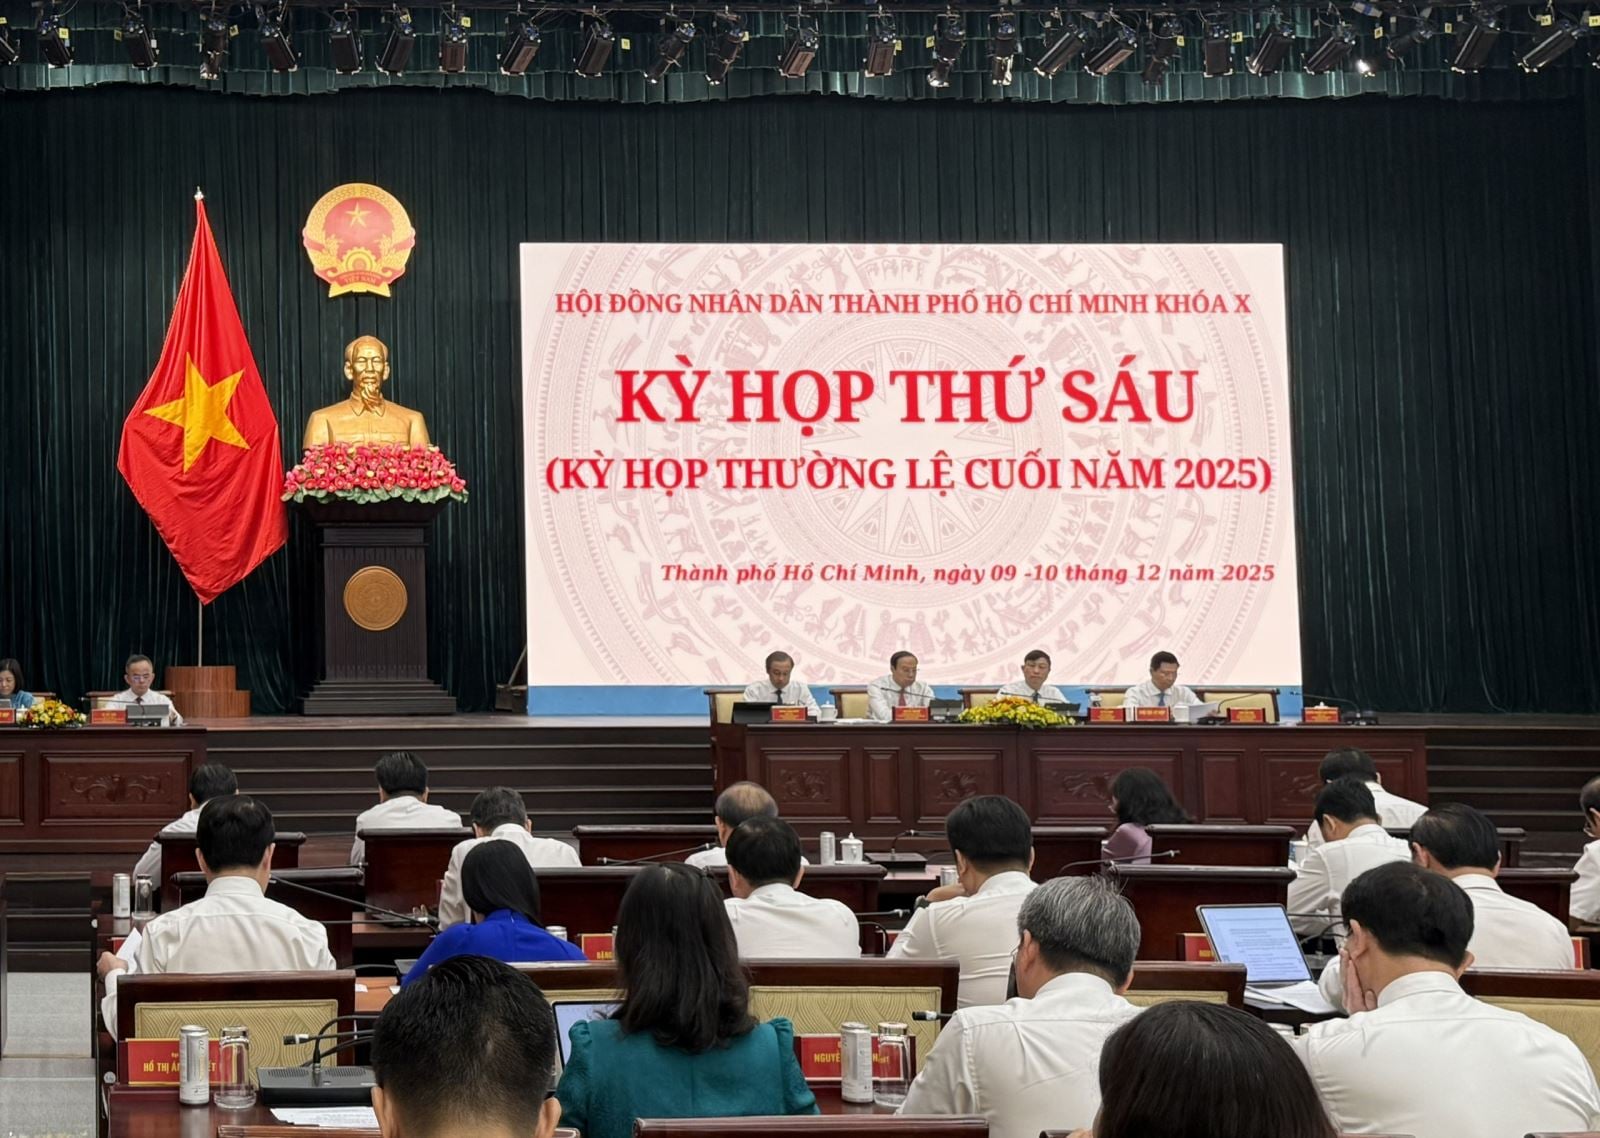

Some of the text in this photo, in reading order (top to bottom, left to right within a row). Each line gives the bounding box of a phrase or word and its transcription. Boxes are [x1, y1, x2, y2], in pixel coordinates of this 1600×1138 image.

[555, 288, 1251, 317] HỘI ĐỒNG NHÂN DÂN THÀNH PHỐ HỒ CHÍ MINH KHÓA X
[614, 354, 1199, 437] KỲ HỌP THỨ SÁU
[545, 448, 1273, 498] (KỲ HỌP THƯỜNG LỆ CUỐI NĂM 2025)
[661, 564, 729, 582] Thành
[735, 562, 777, 585] phố
[782, 562, 815, 582] Hồ
[820, 563, 857, 582] Chí
[863, 564, 927, 584] Minh,
[933, 564, 985, 585] ngày
[990, 564, 1017, 582] 09
[1065, 564, 1129, 585] tháng
[1136, 564, 1161, 581] 12
[1168, 564, 1215, 582] năm
[1222, 564, 1276, 582] 2025
[157, 1062, 170, 1075] THỊ
